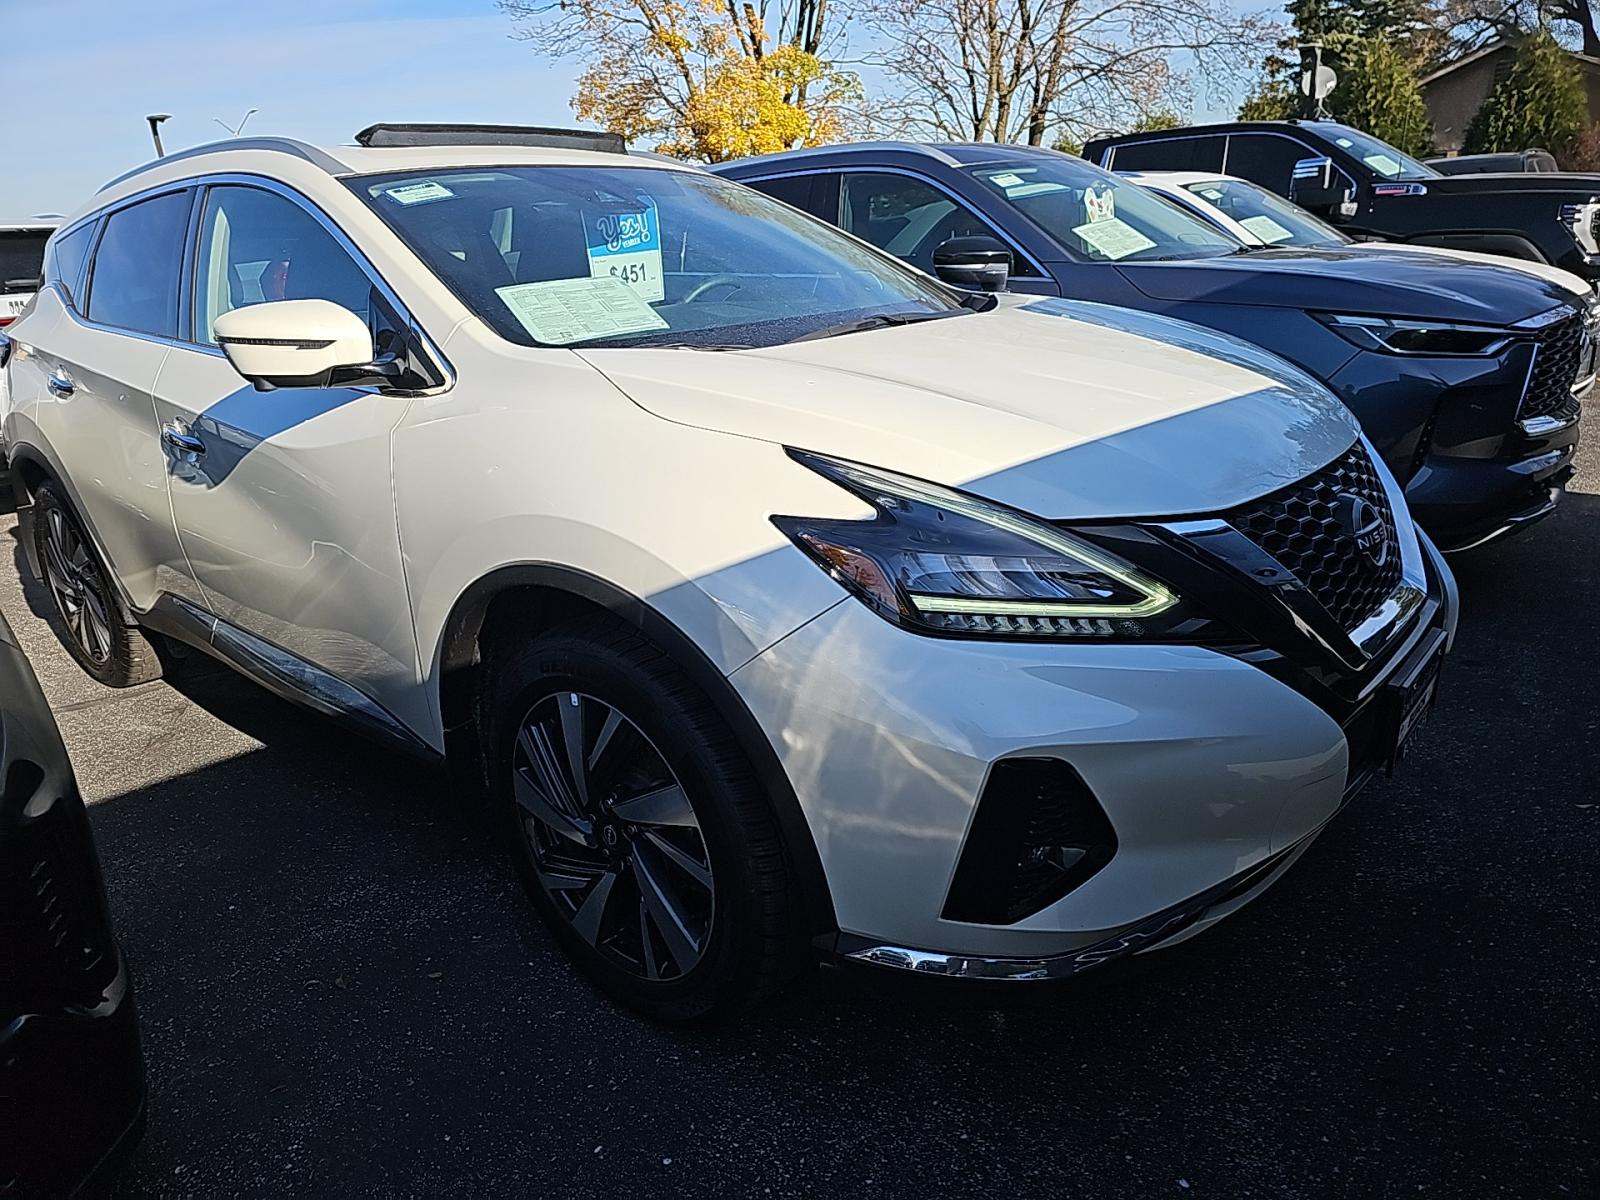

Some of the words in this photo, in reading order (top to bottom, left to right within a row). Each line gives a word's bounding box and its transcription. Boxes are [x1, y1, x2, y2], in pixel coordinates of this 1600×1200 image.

[597, 213, 651, 251] Yes!
[609, 262, 647, 284] $451
[1357, 527, 1387, 550] NISS
